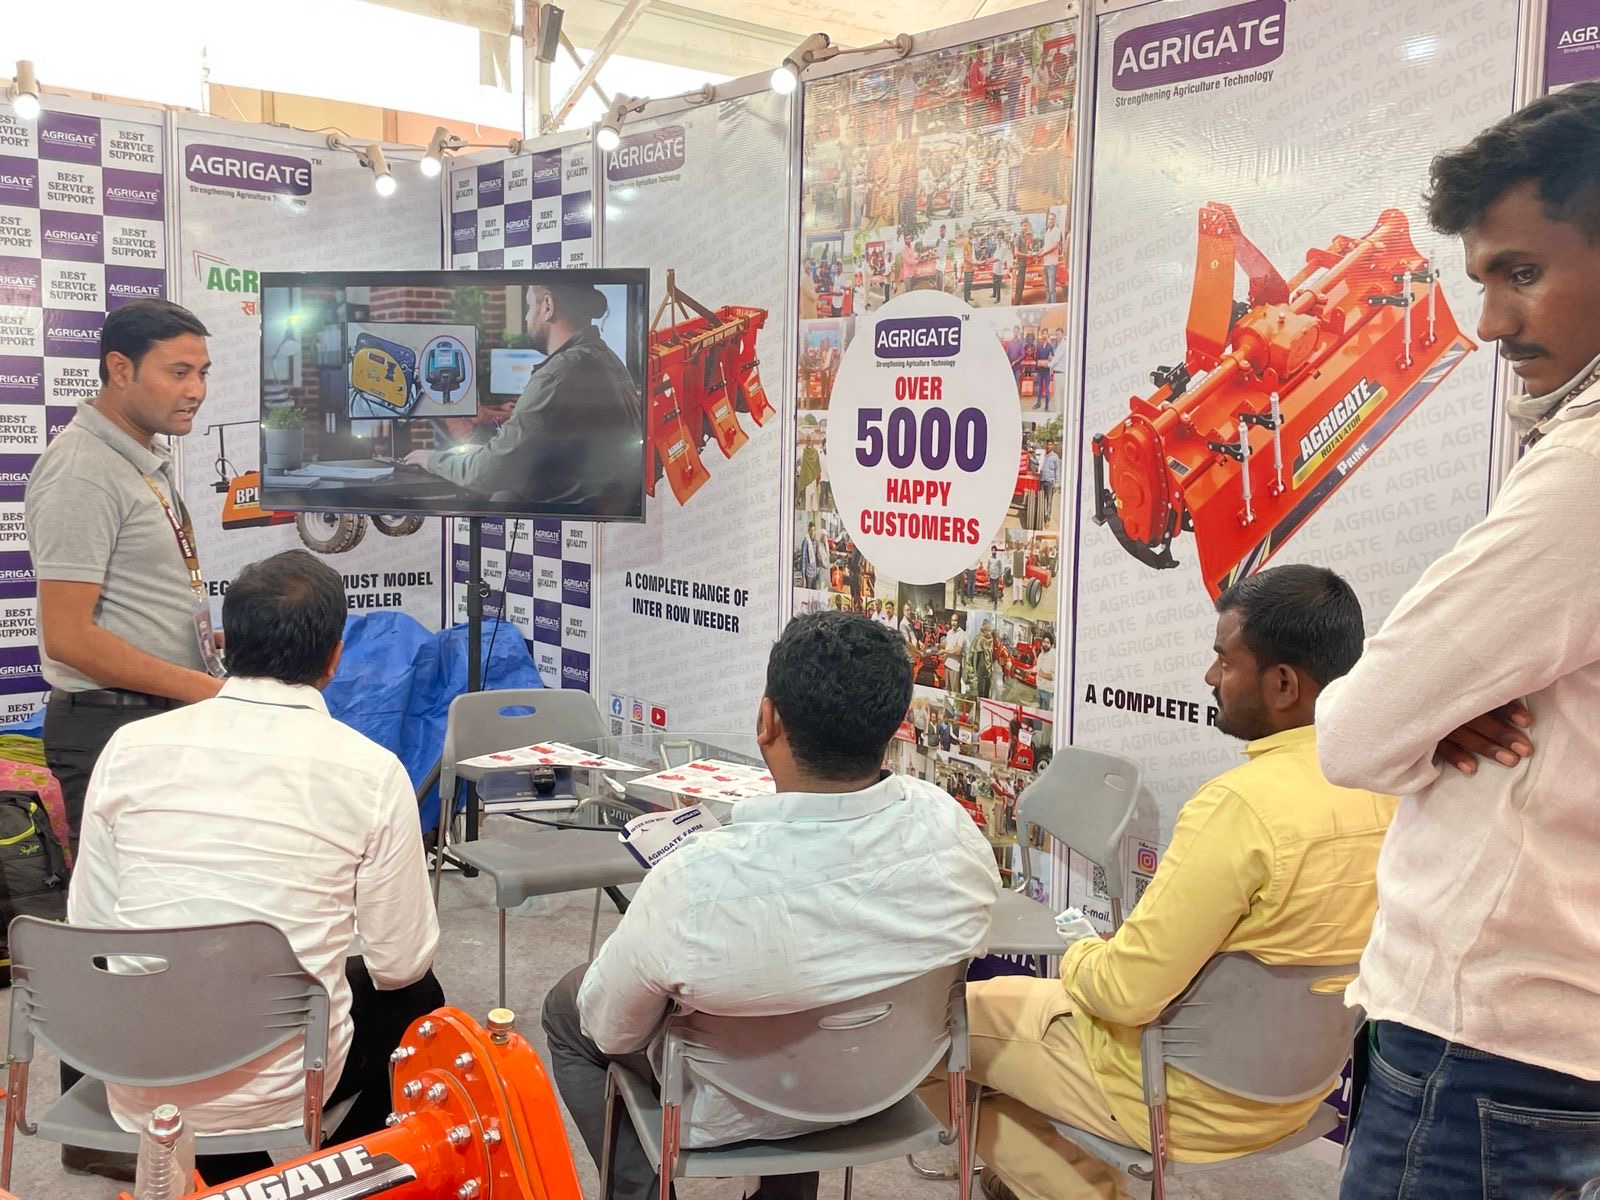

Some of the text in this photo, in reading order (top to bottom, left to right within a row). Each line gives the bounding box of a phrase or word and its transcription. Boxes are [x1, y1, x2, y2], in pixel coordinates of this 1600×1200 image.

[1559, 26, 1600, 46] AGR
[1117, 14, 1280, 76] AGRIGATE
[1116, 70, 1274, 107] Strengthening Agriculture Technology
[0, 126, 28, 136] VICE
[119, 131, 144, 141] BEST
[0, 136, 30, 147] PORT
[42, 130, 96, 144] AGRIGATE
[110, 140, 154, 153] SERVICE
[109, 150, 155, 163] SUPPORT
[609, 137, 684, 170] AGRIGATE
[190, 154, 309, 187] AGRIGATE
[0, 176, 33, 186] IGATE
[58, 172, 84, 183] BEST
[48, 182, 94, 194] SERVICE
[48, 192, 95, 204] SUPPORT
[106, 188, 158, 200] AGRIGATE
[0, 216, 21, 226] EST
[506, 219, 530, 229] AGRIGATE
[0, 226, 32, 237] RVICE
[44, 230, 98, 242] AGRIGATE
[121, 228, 147, 238] BEST
[0, 237, 33, 248] PPORT
[113, 237, 156, 248] SERVICE
[112, 247, 157, 258] SUPPORT
[0, 276, 36, 286] RIGATE
[60, 271, 86, 281] BEST
[207, 267, 259, 293] AGR
[51, 280, 96, 291] SERVICE
[109, 284, 160, 295] AGRIGATE
[50, 291, 98, 301] SUPPORT
[0, 326, 34, 336] RVICE
[48, 328, 100, 338] AGRIGATE
[0, 336, 36, 346] PPORT
[877, 326, 959, 349] AGRIGATE
[876, 359, 956, 369] Strengthening Agriculture Technology
[63, 368, 89, 377] BEST
[0, 374, 39, 384] RIGATE
[54, 378, 98, 387] SERVICE
[53, 387, 100, 397] SUPPORT
[895, 376, 942, 400] OVER
[0, 415, 27, 424] BEST
[1300, 378, 1371, 461] AGRIGATE
[0, 425, 37, 434] ERVICE
[0, 435, 38, 444] UPPORT
[855, 406, 987, 473] 5000
[1320, 415, 1361, 459] ROTAVATOR
[1336, 443, 1370, 476] PRIME
[0, 473, 31, 481] GRIGA
[1385, 452, 1488, 494] AGRIGAT
[887, 478, 951, 506] HAPPY
[0, 523, 25, 531] ERVI
[860, 509, 980, 545] CUSTOMERS
[1394, 510, 1486, 548] AGRIGAT
[0, 533, 27, 541] UPPO
[535, 529, 559, 541] AGRIGATE
[570, 529, 583, 538] BEST
[566, 539, 587, 549] QUALITY
[0, 570, 36, 578] GRIGAT
[541, 569, 554, 578] BEST
[384, 572, 432, 588] MODEL
[537, 579, 557, 589] QUALITY
[564, 578, 589, 590] AGRIGATE
[626, 572, 748, 607] A COMPLETE RANGE OF
[348, 592, 401, 609] EVELER
[5, 609, 32, 617] BEST
[514, 606, 525, 614] BEST
[633, 598, 739, 633] INTER ROW WEEDER
[1146, 603, 1216, 628] AGRIGAT
[0, 618, 35, 627] ERVIC
[535, 615, 559, 627] AGRIGATE
[570, 618, 582, 627] BEST
[0, 628, 36, 637] UPPOR
[566, 628, 587, 638] QUALITY
[1079, 617, 1136, 642] GRIGATE
[542, 655, 553, 664] BEST
[0, 665, 42, 674] GRIGAT
[538, 663, 557, 675] QUALITY
[563, 666, 588, 680] AGRIGATE
[8, 703, 35, 712] BEST
[1085, 684, 1220, 726] A COMPLETE R
[0, 713, 32, 723] SERVI
[1168, 746, 1240, 770] AGRIGAT
[648, 835, 682, 861] AGRIGATE
[683, 824, 703, 837] FARM
[201, 1145, 374, 1200] IGATE
